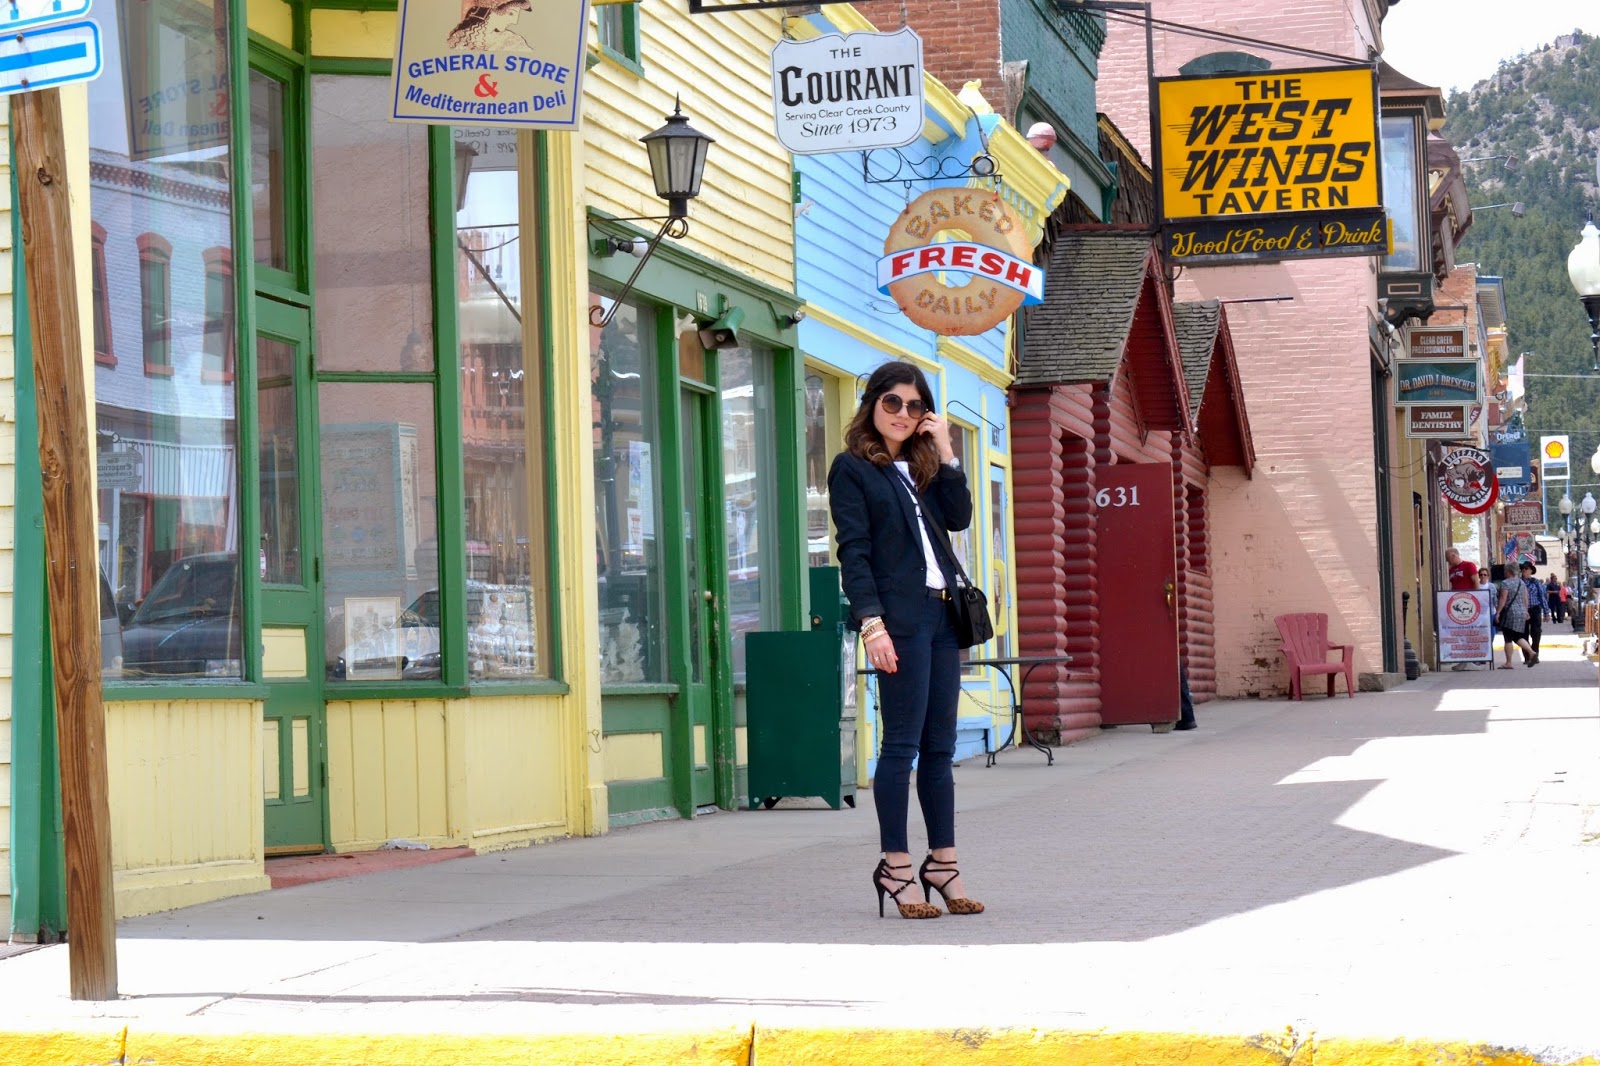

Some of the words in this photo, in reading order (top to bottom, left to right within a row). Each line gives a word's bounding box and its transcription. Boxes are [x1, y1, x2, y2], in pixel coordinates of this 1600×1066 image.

[829, 47, 862, 59] THE
[408, 53, 499, 79] GENERAL
[504, 55, 570, 84] STORE
[474, 73, 499, 98] &
[1235, 79, 1302, 100] THE
[405, 84, 528, 115] Mediterranean
[533, 90, 567, 112] Deli
[785, 112, 817, 121] Serving
[818, 109, 843, 118] Clear
[846, 106, 873, 116] Creek
[876, 104, 911, 114] County
[1185, 98, 1352, 147] WEST
[800, 121, 843, 138] Since
[848, 116, 897, 134] 1973
[1180, 142, 1371, 192] WINDS
[1193, 186, 1349, 214] TAVERN
[905, 194, 1014, 239] BAKED
[1170, 230, 1231, 257] Good
[1231, 225, 1300, 256] Food
[1296, 226, 1313, 250] &
[1323, 220, 1382, 247] Drink
[891, 246, 1032, 288] FRESH
[914, 287, 998, 315] DAILY
[1412, 374, 1434, 389] DAVID
[1441, 375, 1476, 392] DRESCHER
[1412, 421, 1463, 429] DENTISTRY
[1421, 411, 1454, 419] FAMILY
[1446, 449, 1483, 462] BUFFALO
[1095, 485, 1140, 508] 631
[1438, 476, 1470, 503] RESTAURANT
[1475, 485, 1489, 500] BAR
[1499, 485, 1526, 497] MALL
